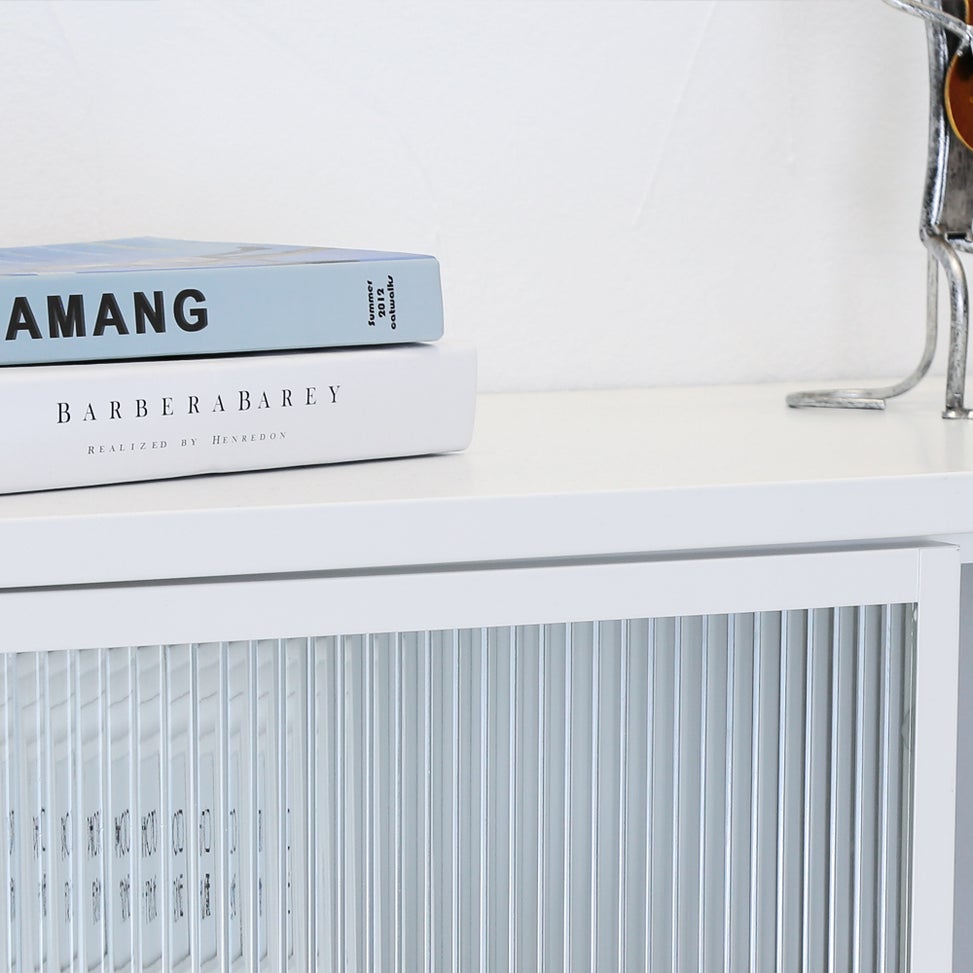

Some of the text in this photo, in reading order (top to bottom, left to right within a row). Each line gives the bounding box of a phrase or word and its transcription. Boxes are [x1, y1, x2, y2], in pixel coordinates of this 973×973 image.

[5, 288, 209, 341] AMANG
[367, 280, 375, 326] Summer
[377, 288, 386, 318] 2012
[87, 440, 168, 455] REALIZED
[181, 437, 199, 448] BY
